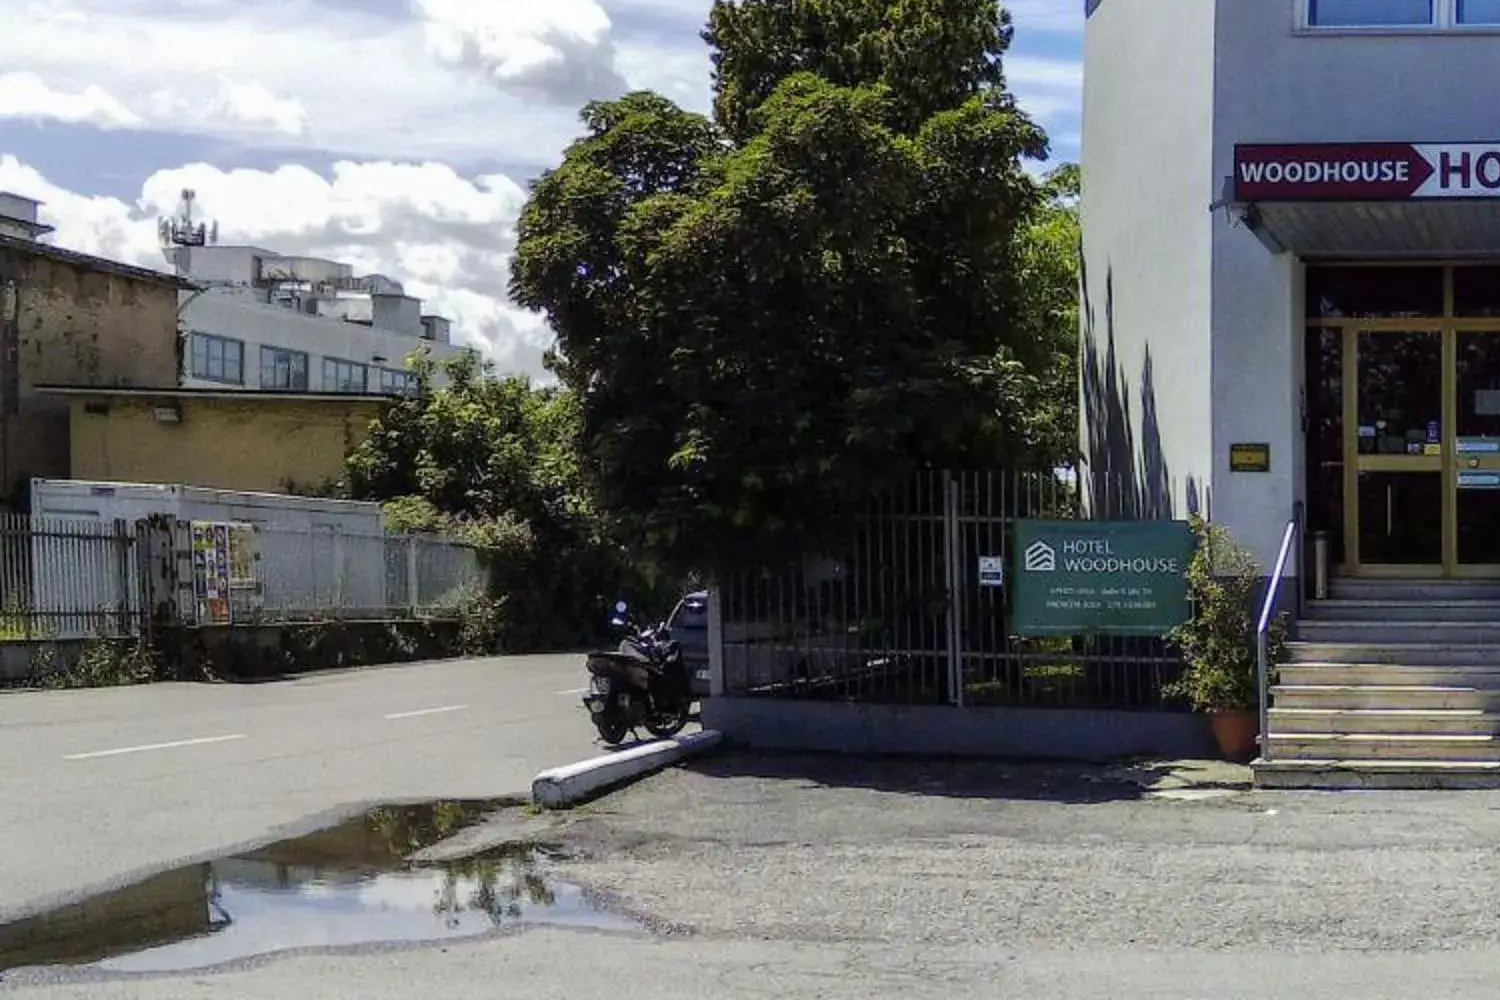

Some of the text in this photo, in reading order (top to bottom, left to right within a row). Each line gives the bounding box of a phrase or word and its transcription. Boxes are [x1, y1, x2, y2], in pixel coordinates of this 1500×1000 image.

[1240, 160, 1409, 183] WOODHOUSE
[1063, 539, 1114, 555] HOTEL
[1064, 557, 1178, 573] WOODHOUSE
